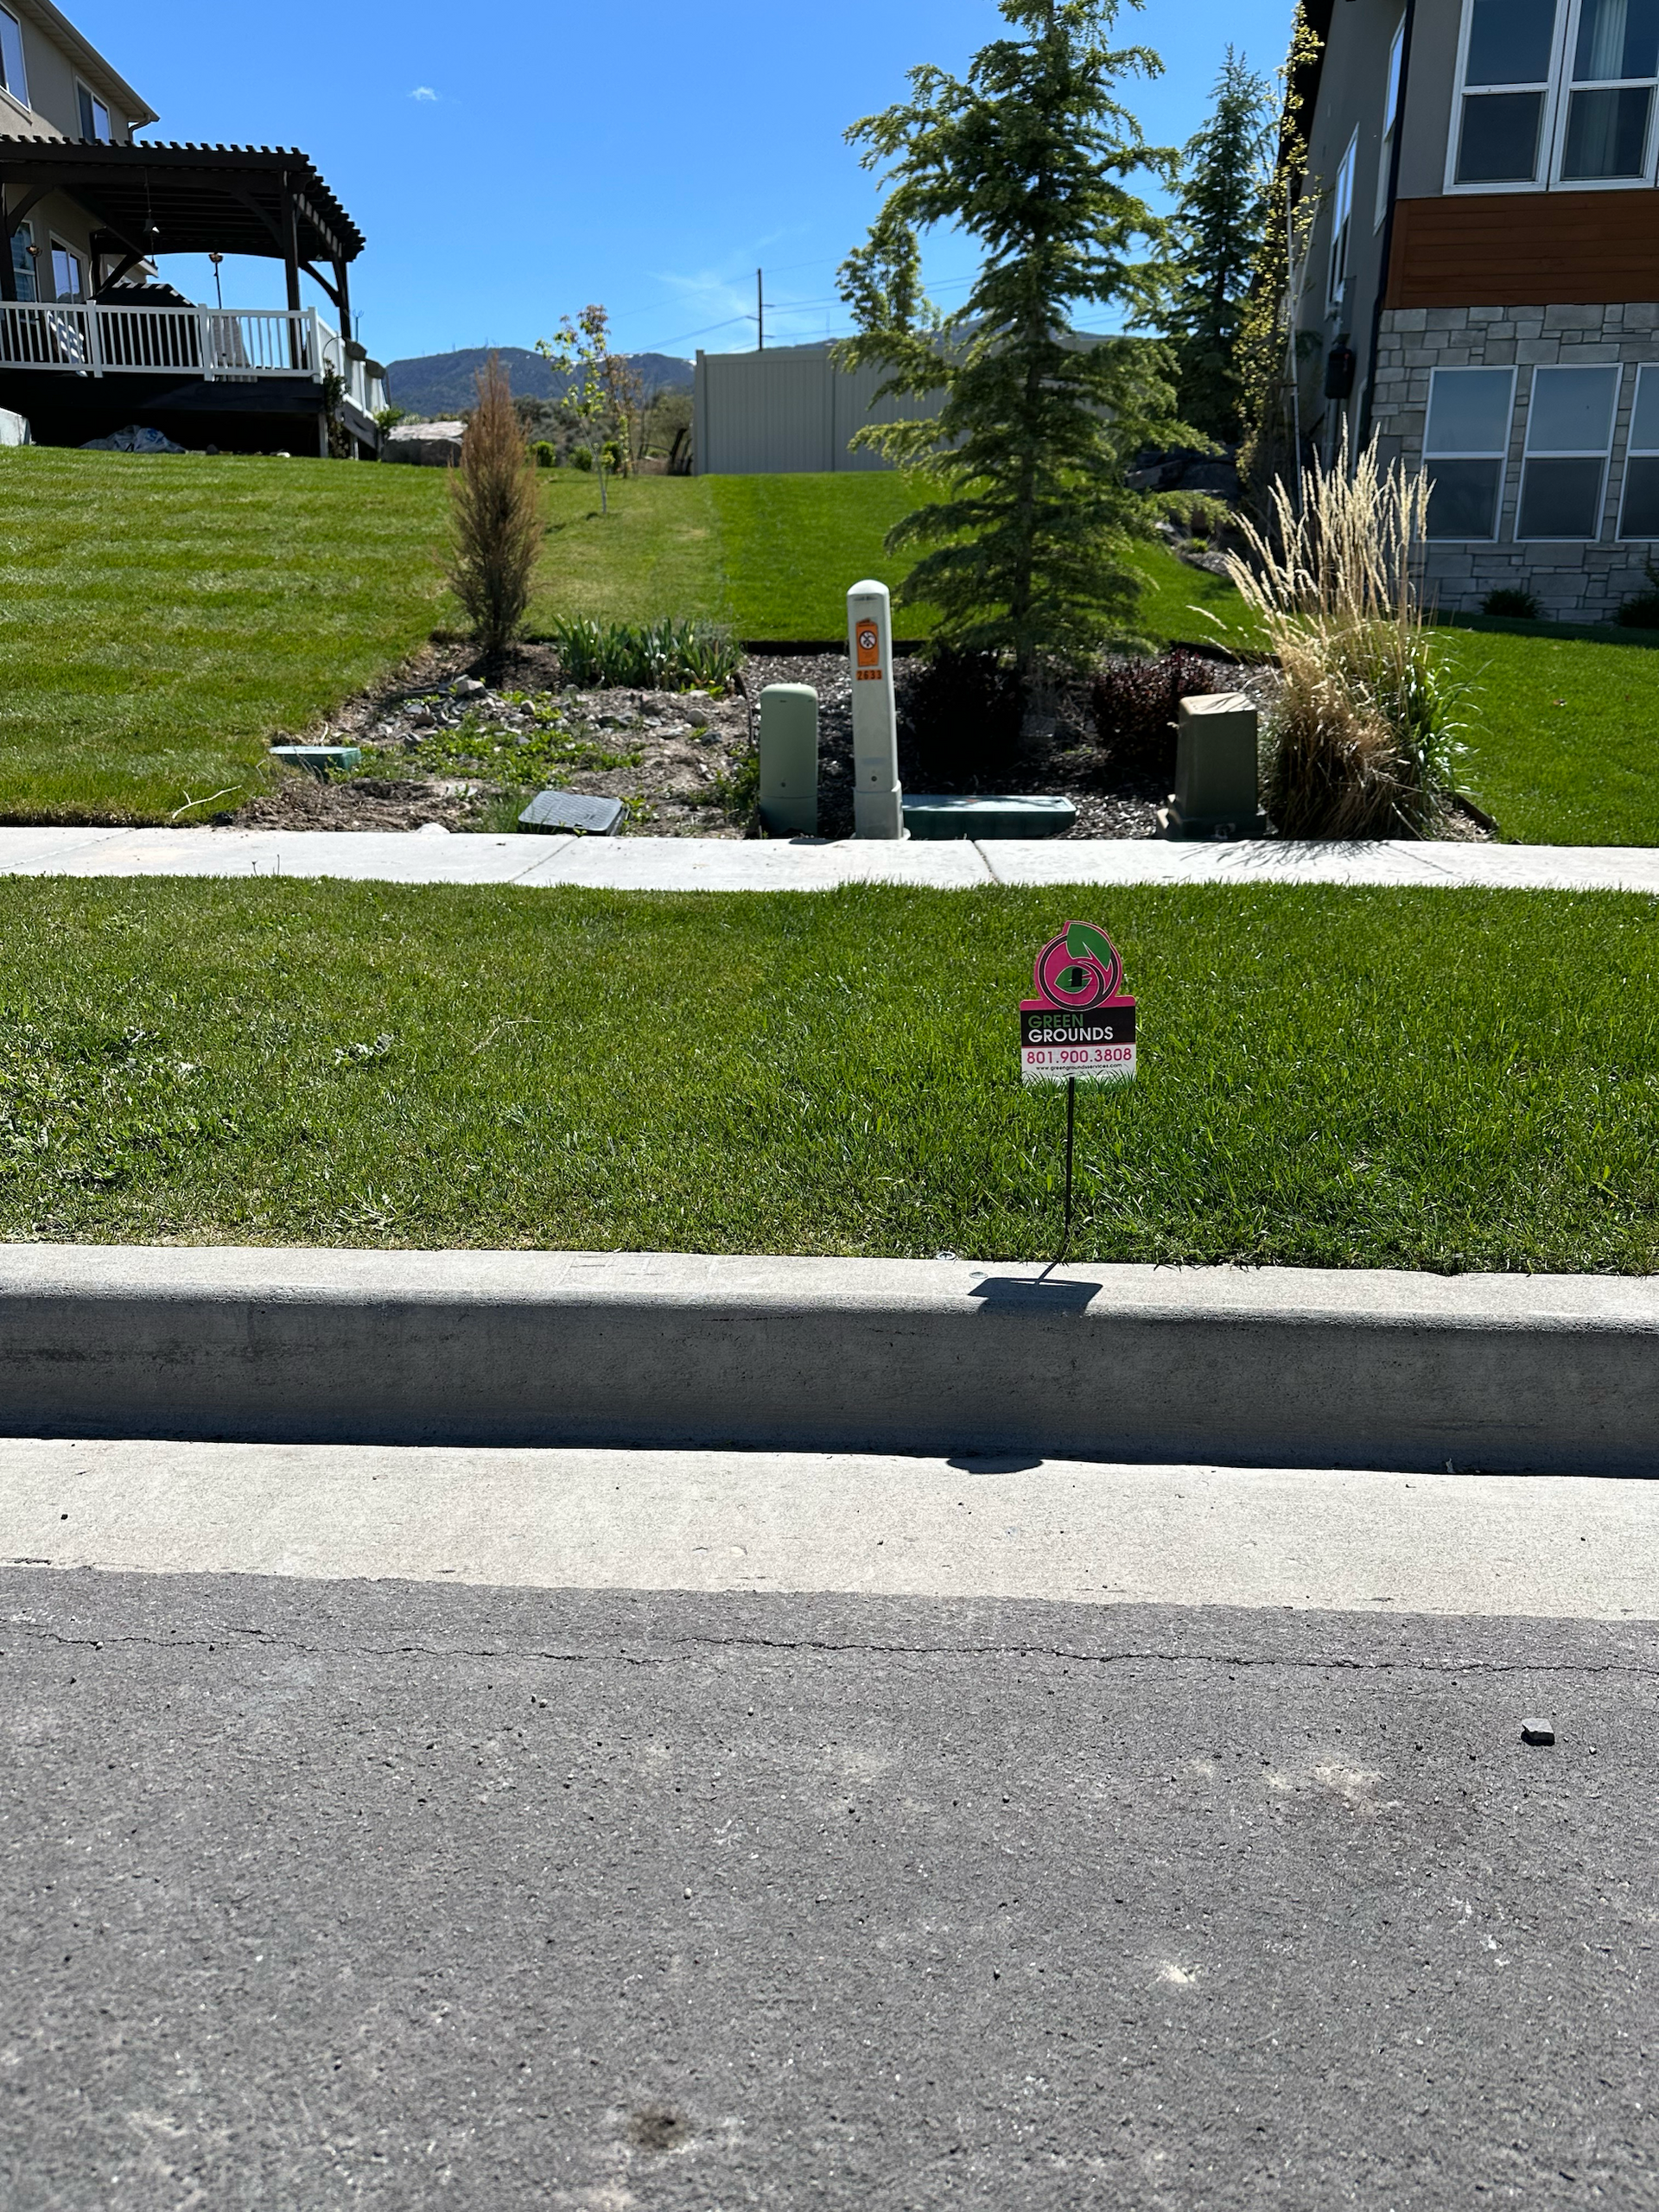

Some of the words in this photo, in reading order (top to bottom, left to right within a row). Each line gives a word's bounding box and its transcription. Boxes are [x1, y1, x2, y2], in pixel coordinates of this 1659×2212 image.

[857, 670, 882, 681] 2633
[1028, 1014, 1084, 1028] GREEN
[1028, 1027, 1113, 1043] GROUNDS
[1027, 1048, 1132, 1065] 801.900.3808
